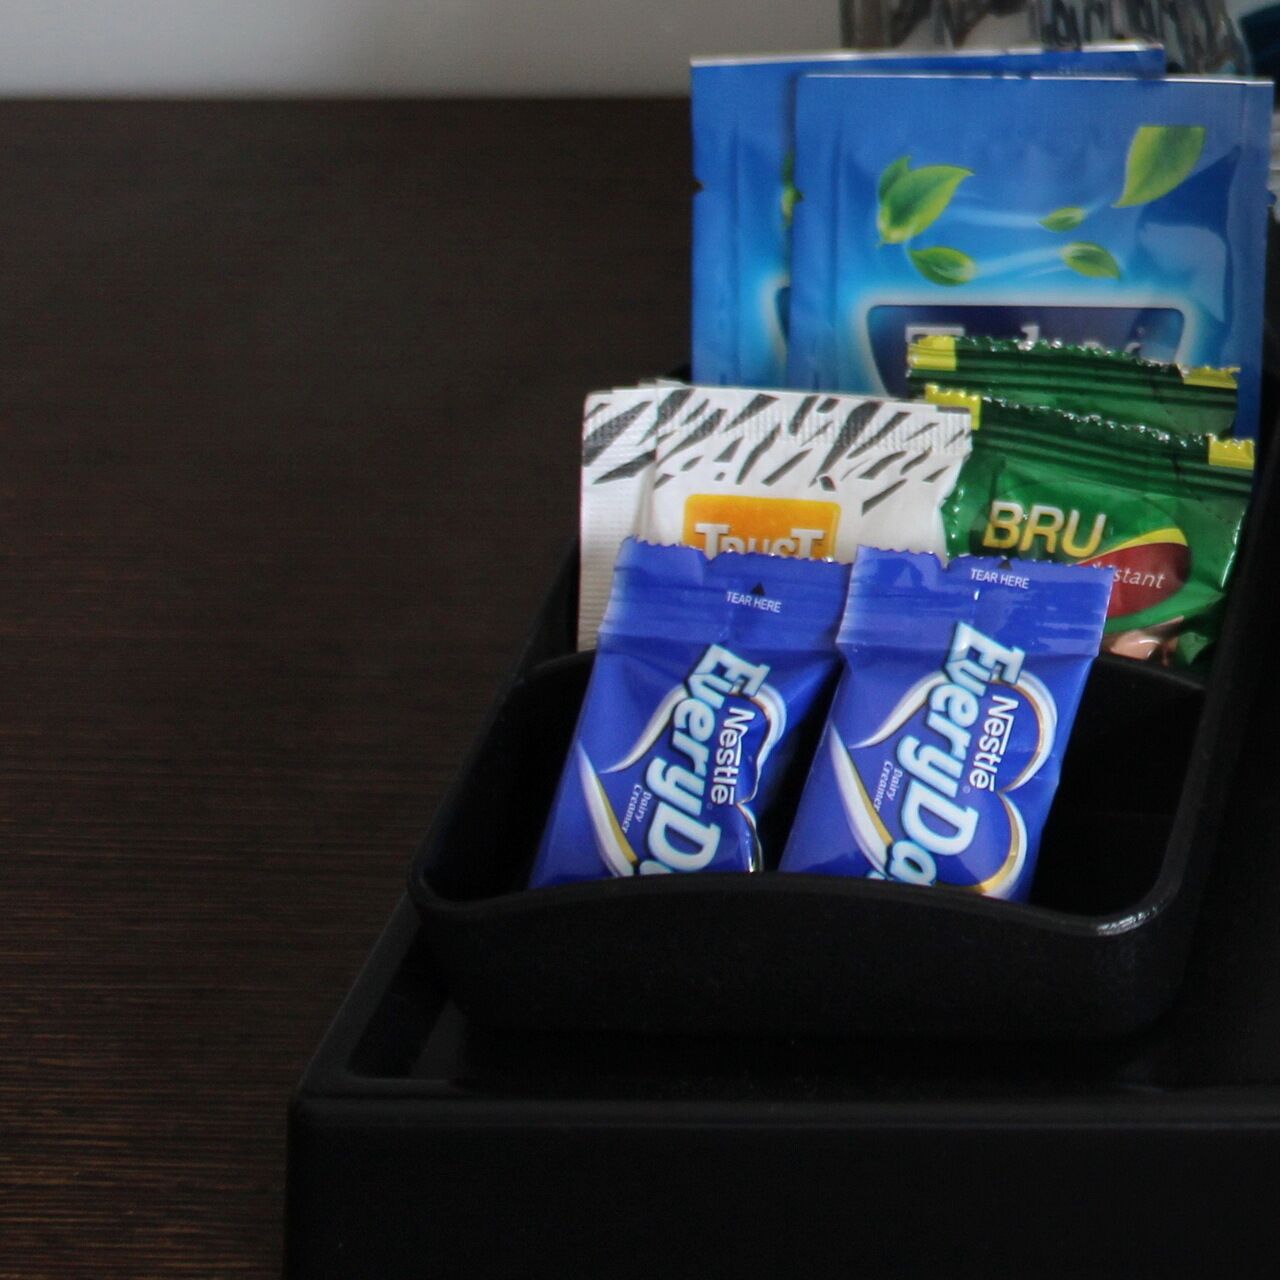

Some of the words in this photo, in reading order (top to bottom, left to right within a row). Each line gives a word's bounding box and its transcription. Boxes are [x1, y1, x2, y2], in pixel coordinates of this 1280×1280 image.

[982, 500, 1107, 558] BRU
[726, 591, 752, 607] TEAR
[753, 597, 782, 613] HERE
[970, 568, 999, 584] TEAR
[1000, 574, 1030, 590] HERE
[640, 643, 771, 873] EveryD
[867, 621, 1026, 886] EveryDa
[622, 783, 644, 834] Creamer
[637, 790, 652, 823] Dairy
[875, 760, 895, 812] Creamer
[888, 767, 904, 801] Dairy
